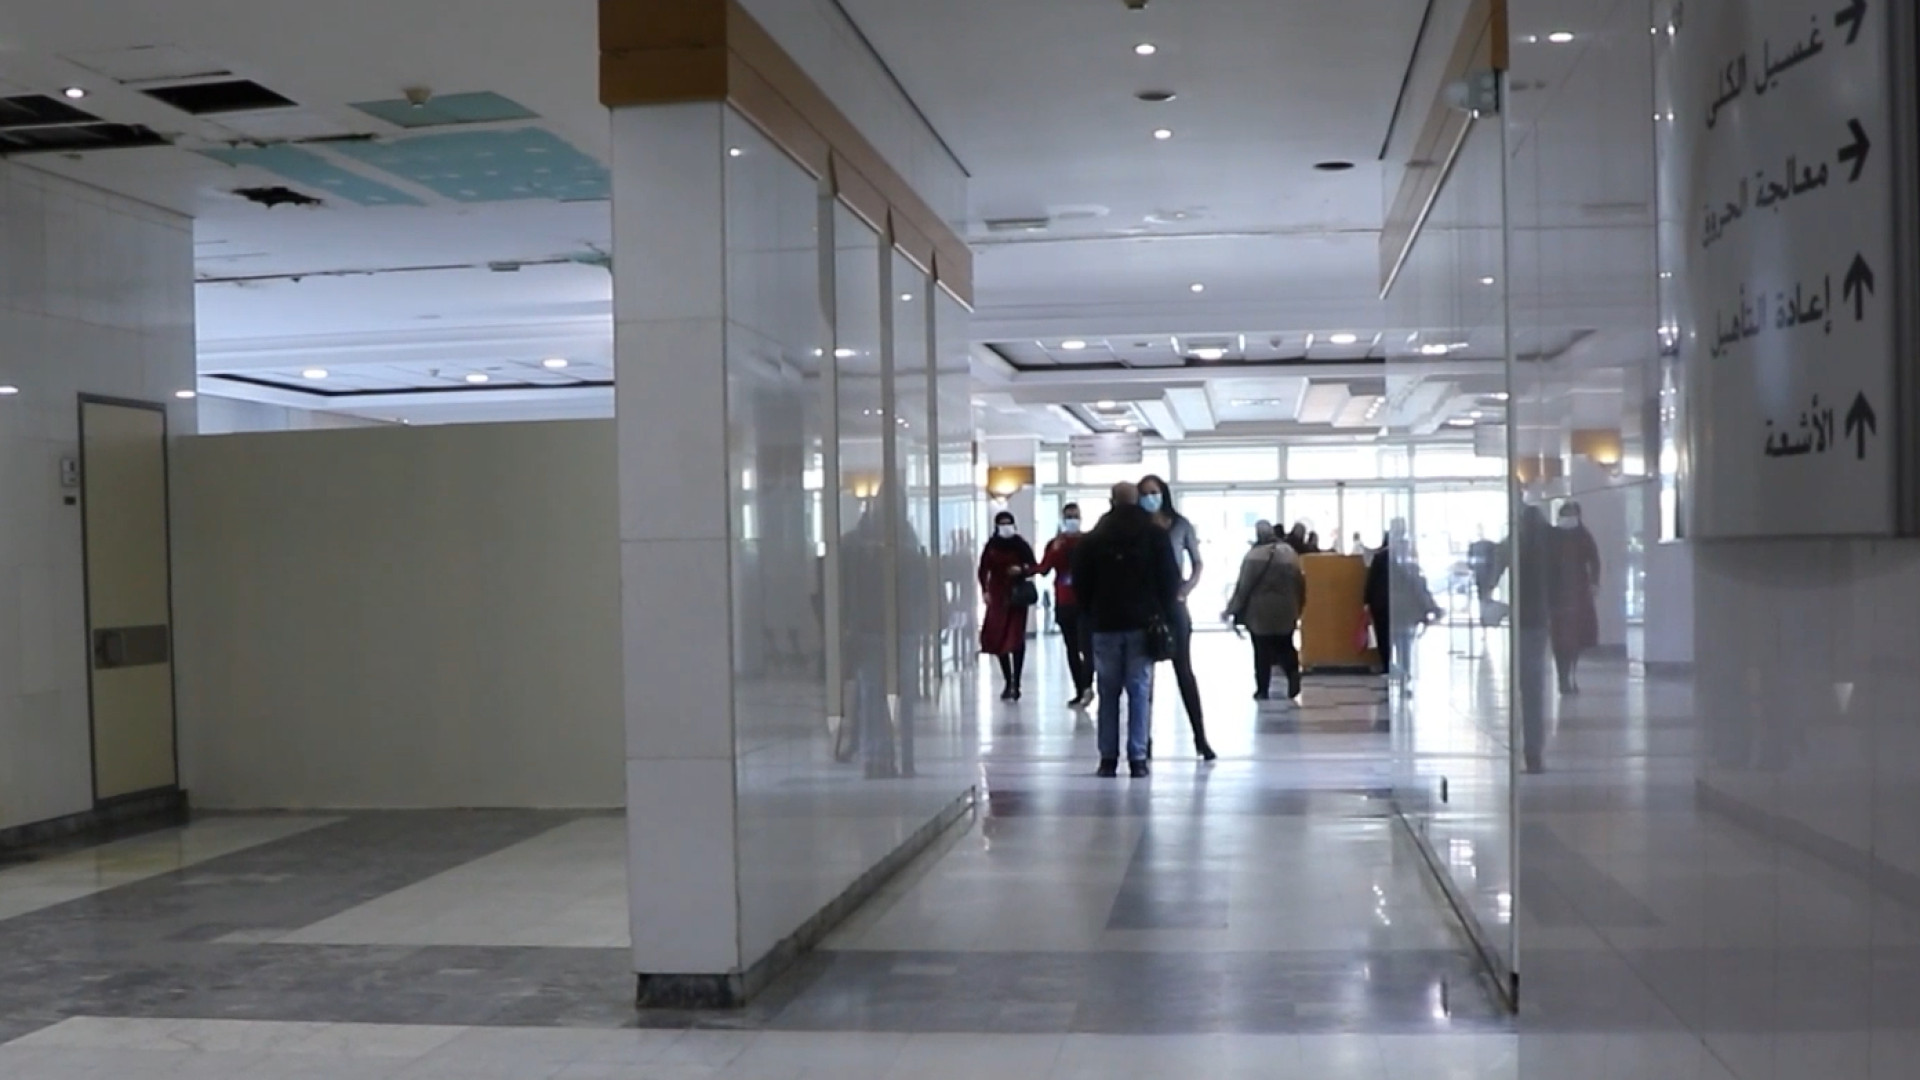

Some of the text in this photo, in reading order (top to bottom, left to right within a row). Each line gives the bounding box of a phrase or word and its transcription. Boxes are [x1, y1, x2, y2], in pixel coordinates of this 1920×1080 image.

[1754, 14, 1823, 95] غسيل
[1756, 155, 1828, 214] معالجة
[1710, 274, 1831, 359] إعادة التأهيل
[1765, 393, 1833, 457] الأشعة
